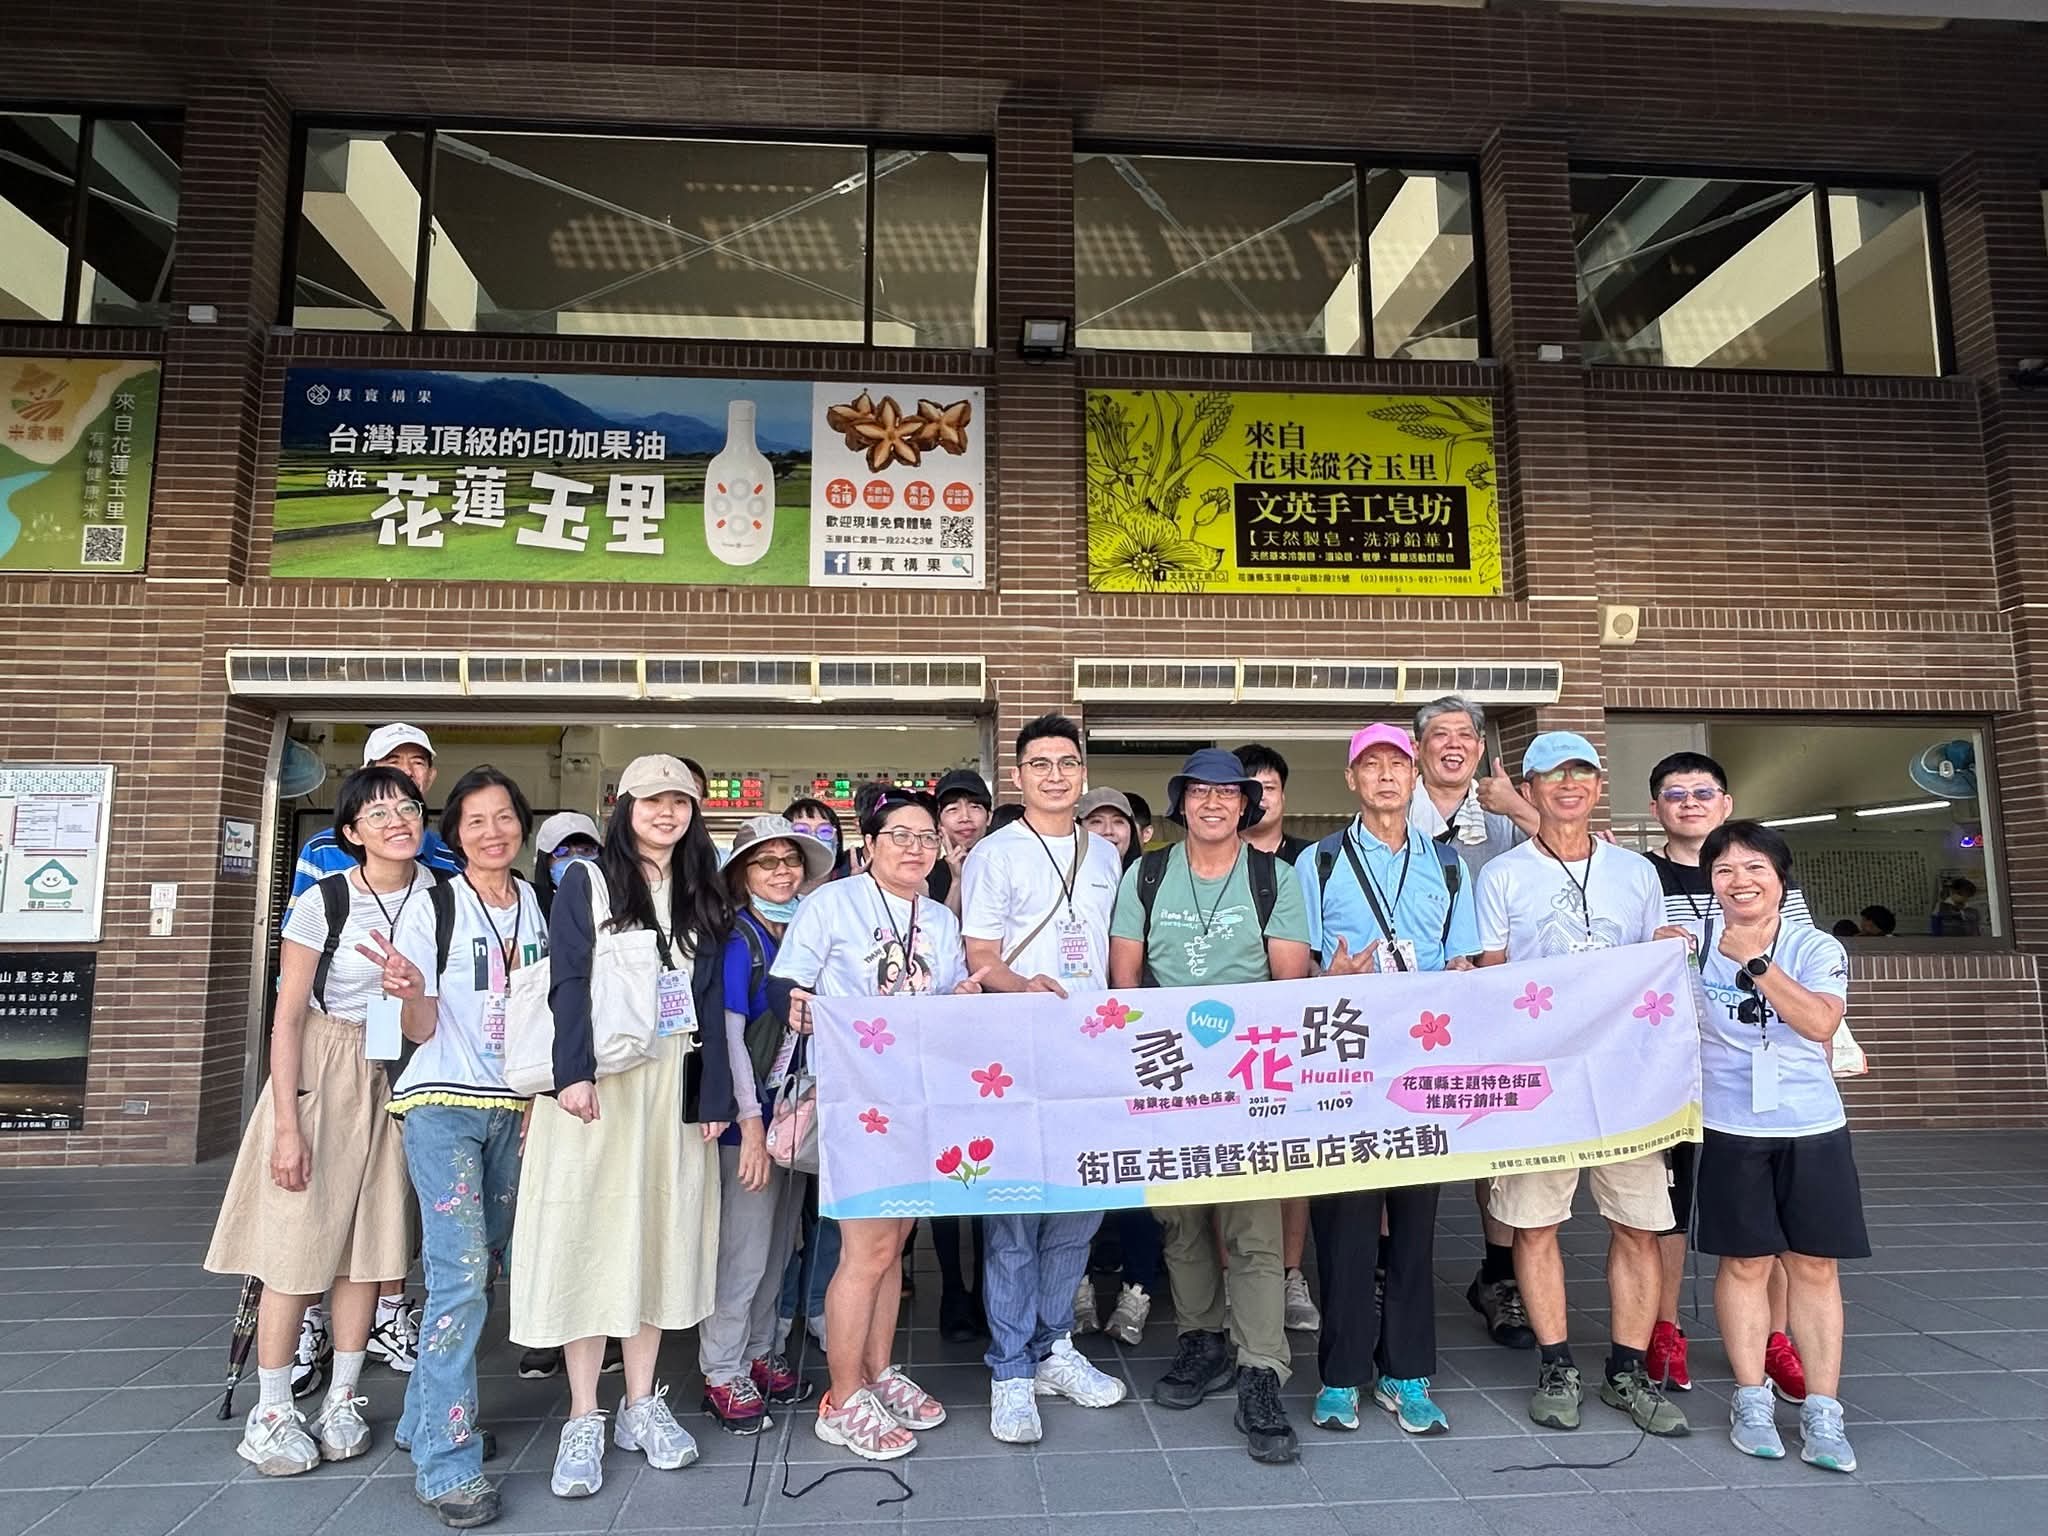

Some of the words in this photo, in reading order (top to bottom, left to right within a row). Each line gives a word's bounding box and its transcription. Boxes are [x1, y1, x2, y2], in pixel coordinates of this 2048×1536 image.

[328, 424, 666, 461] 台灣最頂級的印加果油
[1245, 420, 1305, 450] 來自
[105, 393, 135, 520] 來自花蓮玉里
[1245, 452, 1437, 481] 花東縱谷玉里
[327, 469, 366, 488] 就在
[370, 466, 665, 555] 花蓮玉里
[1247, 491, 1452, 526] 文英手工皂坊
[826, 515, 932, 529] 歡迎現場免費體驗
[1191, 1012, 1230, 1032] Way
[1301, 1069, 1374, 1085] Hualien
[1402, 1073, 1542, 1091] 花蓮縣主題特色街區
[1132, 1090, 1236, 1111] 解鎖花蓮特色店家
[1249, 1104, 1286, 1117] 07/07
[1317, 1097, 1353, 1111] 11/09
[1425, 1093, 1519, 1109] 推廣行銷計畫
[1077, 1123, 1449, 1186] 街區走讀暨街區店家活動
